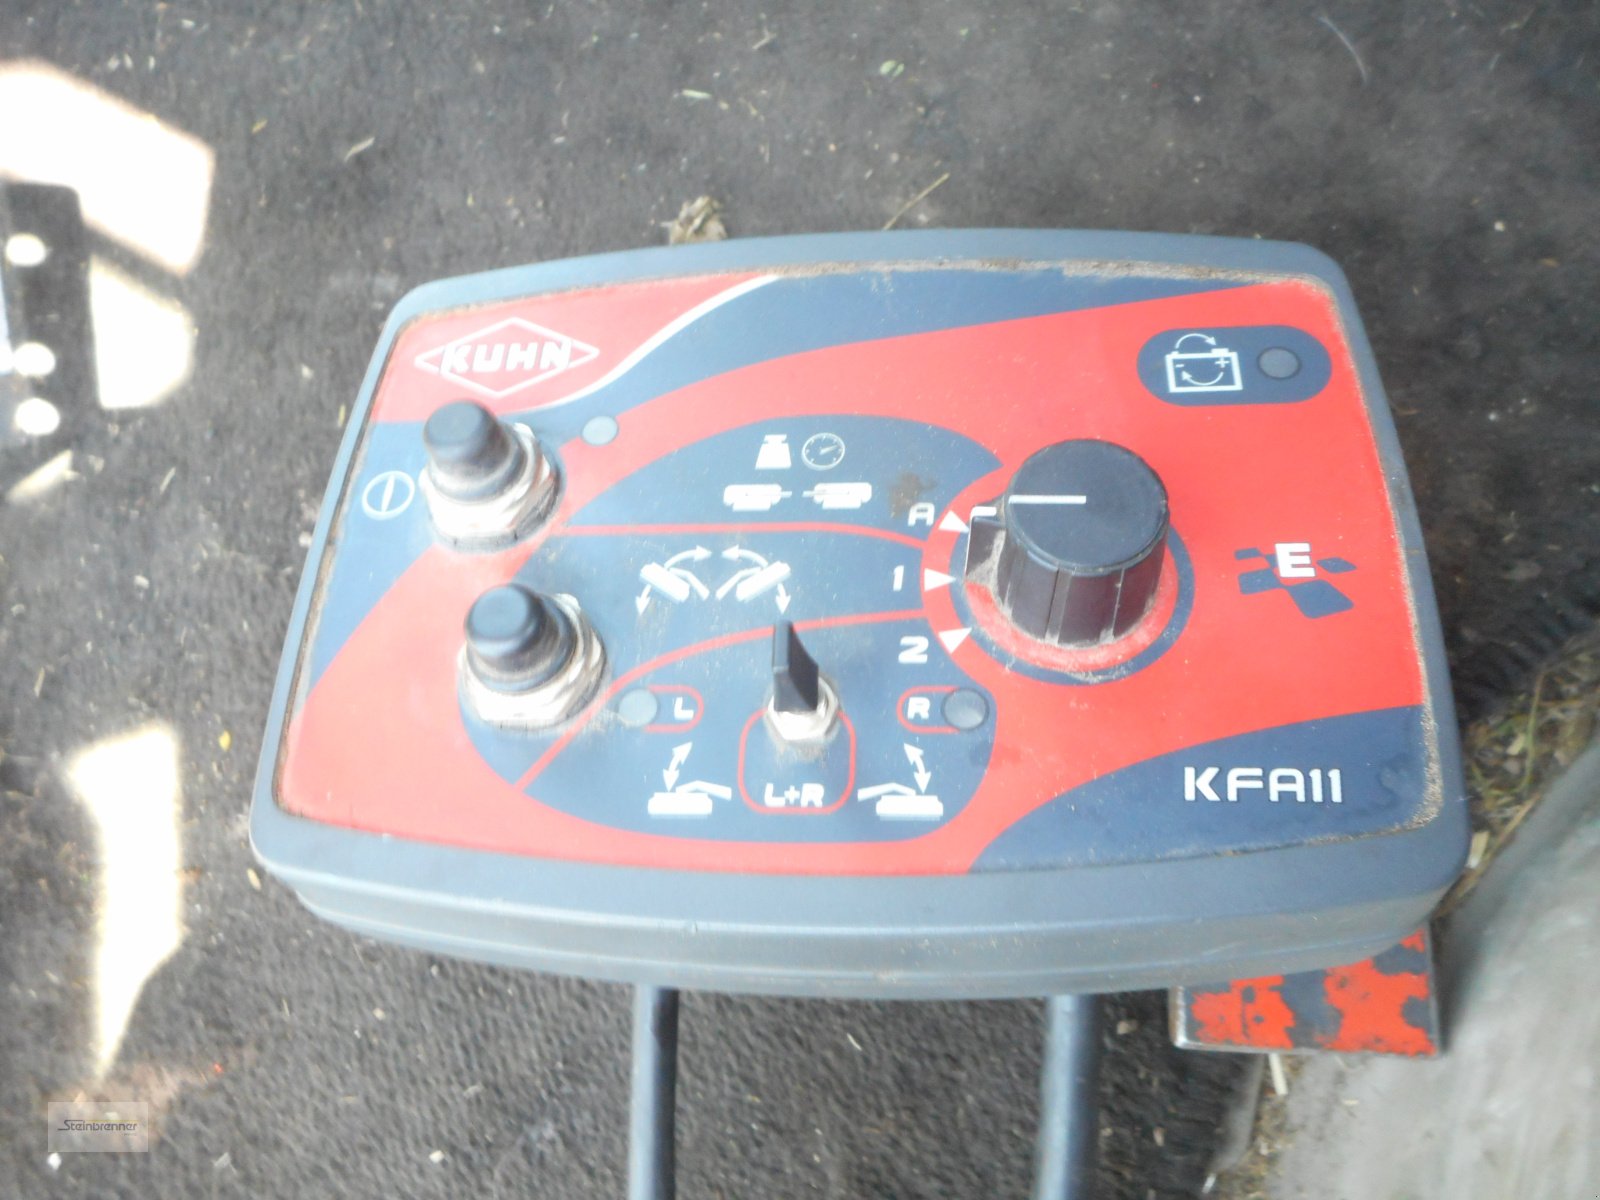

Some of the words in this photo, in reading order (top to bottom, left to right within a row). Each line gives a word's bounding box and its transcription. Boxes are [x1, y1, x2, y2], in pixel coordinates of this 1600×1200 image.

[440, 341, 572, 374] KUHN
[908, 502, 935, 526] A
[1275, 542, 1316, 578] E
[893, 565, 904, 591] 1
[898, 636, 929, 664] 2
[674, 696, 694, 720] L
[907, 697, 930, 719] R
[764, 782, 824, 808] L+R
[1184, 766, 1343, 803] KFA11
